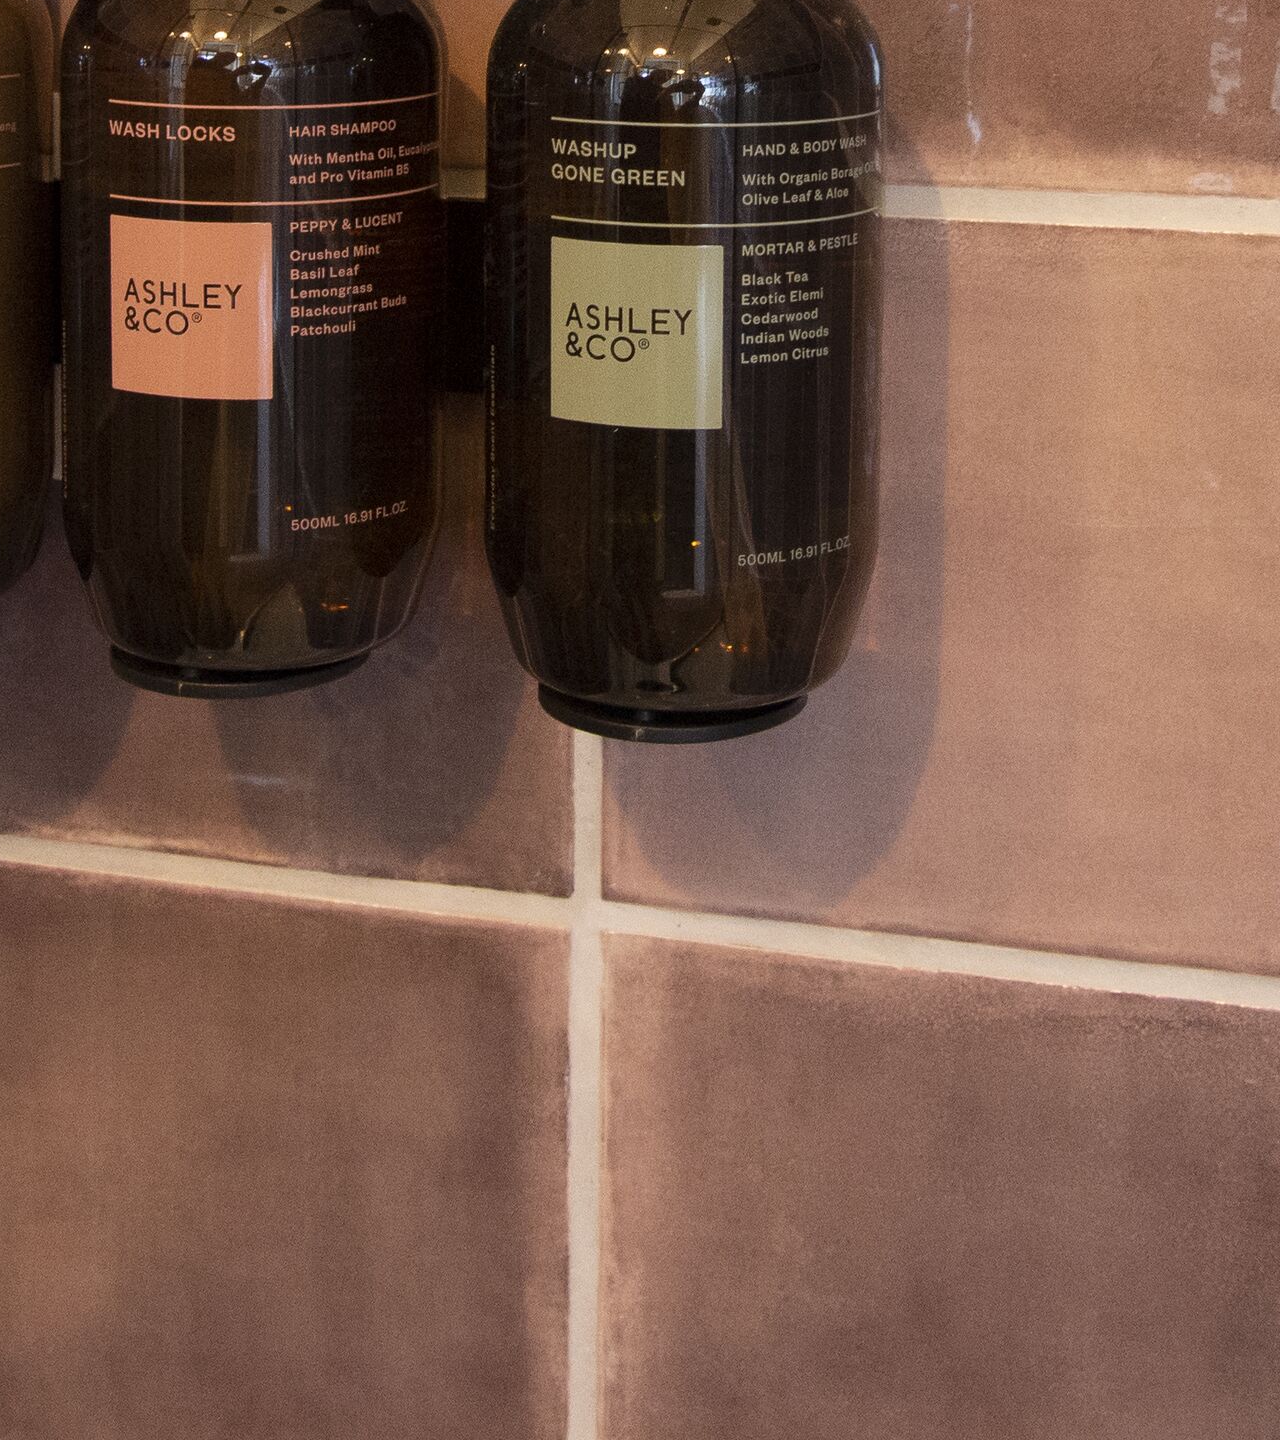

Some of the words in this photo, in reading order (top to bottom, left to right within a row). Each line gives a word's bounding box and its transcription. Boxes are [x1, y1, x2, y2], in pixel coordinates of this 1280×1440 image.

[109, 119, 160, 139] WASH
[166, 124, 236, 142] LOCKS
[289, 125, 326, 137] HAIR
[331, 119, 396, 136] SHAMPOO
[551, 138, 637, 159] WASHUP
[742, 143, 786, 157] HAND
[789, 142, 800, 155] &
[803, 138, 837, 153] BODY
[839, 134, 867, 150] WASH
[289, 153, 322, 166] With
[327, 151, 374, 165] Mentha
[378, 148, 396, 161] Oil,
[289, 173, 315, 185] and
[321, 171, 344, 183] Pro
[347, 166, 394, 181] Vitamin
[396, 163, 409, 176] B5
[551, 163, 605, 183] GONE
[611, 168, 685, 187] GREEN
[742, 174, 775, 186] With
[779, 169, 828, 186] Organic
[831, 165, 863, 179] Borage
[742, 192, 779, 206] Olive
[782, 189, 812, 204] Leaf
[814, 189, 823, 201] &
[826, 187, 849, 200] Aloe
[290, 219, 338, 233] PEPPY
[341, 218, 352, 230] &
[355, 211, 403, 229] LUCENT
[290, 247, 349, 261] Crushed
[353, 244, 380, 258] Mint
[741, 241, 804, 257] MORTAR
[807, 240, 817, 252] &
[819, 232, 859, 251] PESTLE
[290, 267, 325, 281] Basil
[329, 264, 360, 278] Leaf
[741, 273, 782, 286] Black
[785, 271, 809, 283] Tea
[124, 277, 242, 310] ASHLEY
[290, 283, 373, 299] Lemongrass
[741, 292, 786, 306] Exotic
[790, 287, 824, 303] Elemi
[290, 300, 378, 318] Blackcurrant
[381, 294, 407, 309] Buds
[741, 307, 819, 326] Cedarwood
[290, 320, 356, 337] Patchouli
[565, 302, 693, 335] ASHLEY
[741, 331, 785, 345] Indian
[788, 325, 830, 342] Woods
[741, 351, 788, 364] Lemon
[792, 346, 829, 360] Citrus
[290, 515, 340, 531] 500ML
[343, 509, 372, 525] 16.91
[738, 551, 787, 567] 500ML
[790, 545, 818, 561] 16.91
